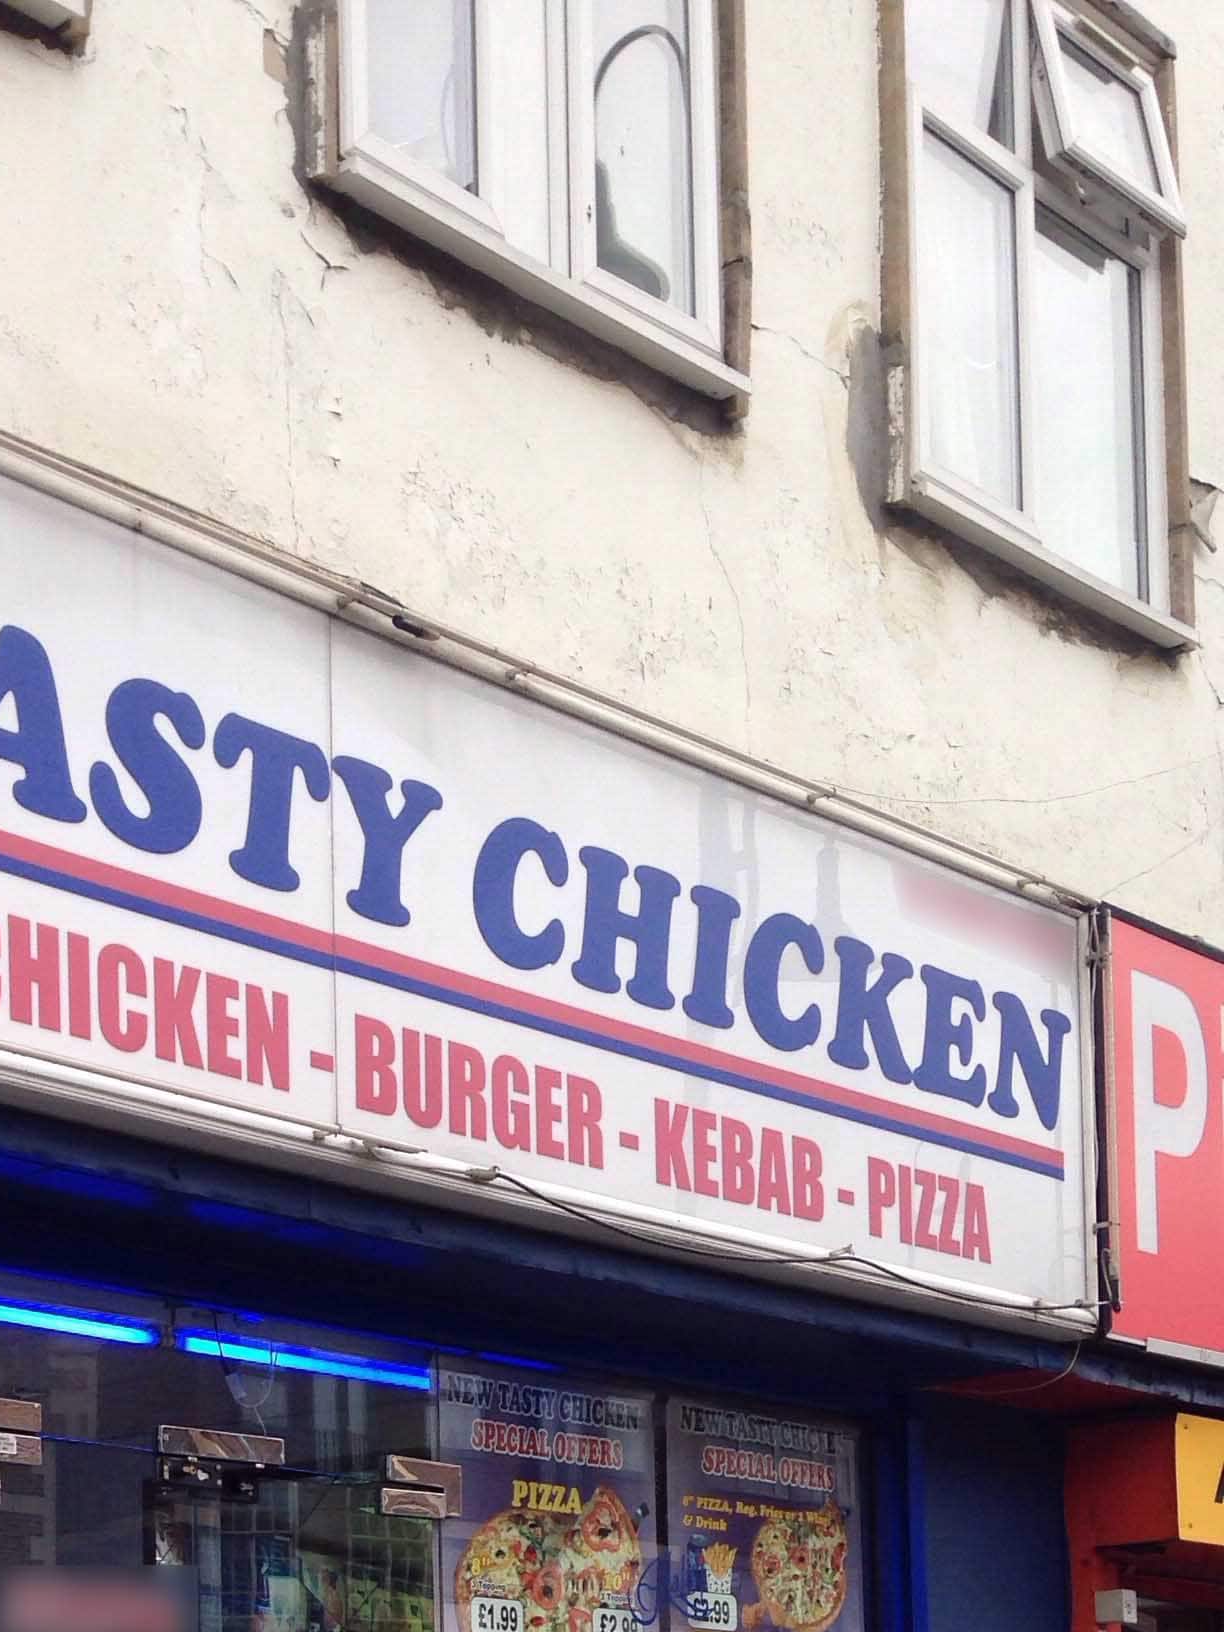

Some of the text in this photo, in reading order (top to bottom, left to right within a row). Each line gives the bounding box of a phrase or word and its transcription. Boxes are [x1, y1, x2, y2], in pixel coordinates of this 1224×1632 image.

[473, 816, 1072, 1132] CHICKEN
[1130, 968, 1224, 1256] P
[354, 1013, 605, 1170] BURGER
[653, 1097, 825, 1223] KEBAB
[866, 1155, 993, 1266] PIZZA
[447, 1374, 640, 1430] NEW TASTY CHICKEN
[471, 1419, 623, 1469] SPECIAL OFFERS
[701, 1445, 836, 1492] SPECIAL OFFERS
[512, 1479, 584, 1514] PIZZA
[696, 1516, 727, 1531] Drink
[478, 1603, 518, 1632] £1.99
